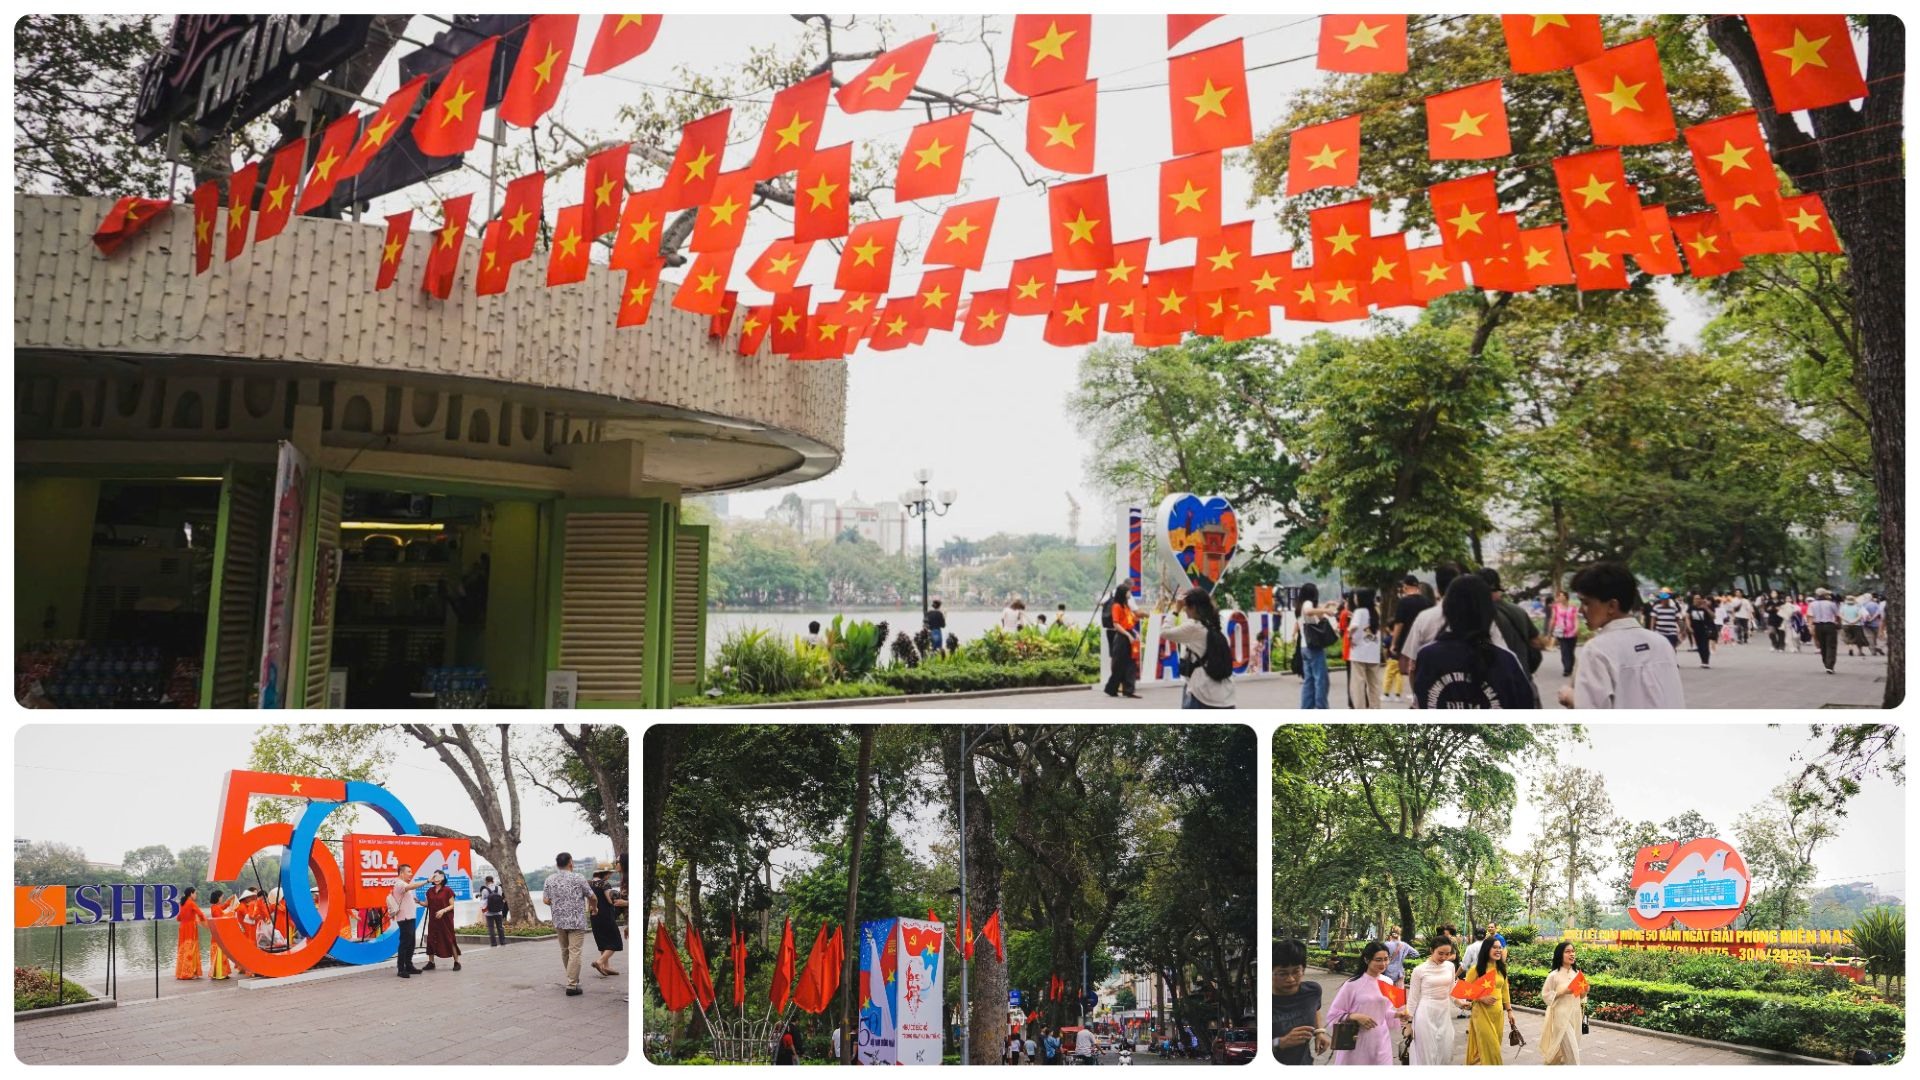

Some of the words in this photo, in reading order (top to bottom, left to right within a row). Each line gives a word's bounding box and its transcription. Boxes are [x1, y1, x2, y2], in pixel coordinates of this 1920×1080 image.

[360, 849, 399, 870] 30.4
[207, 769, 421, 978] 50
[74, 884, 180, 925] SHB
[1639, 891, 1660, 903] 30.4
[1645, 930, 1658, 941] 50
[1683, 928, 1710, 943] NGÀY
[1736, 927, 1777, 944] PHÓNG
